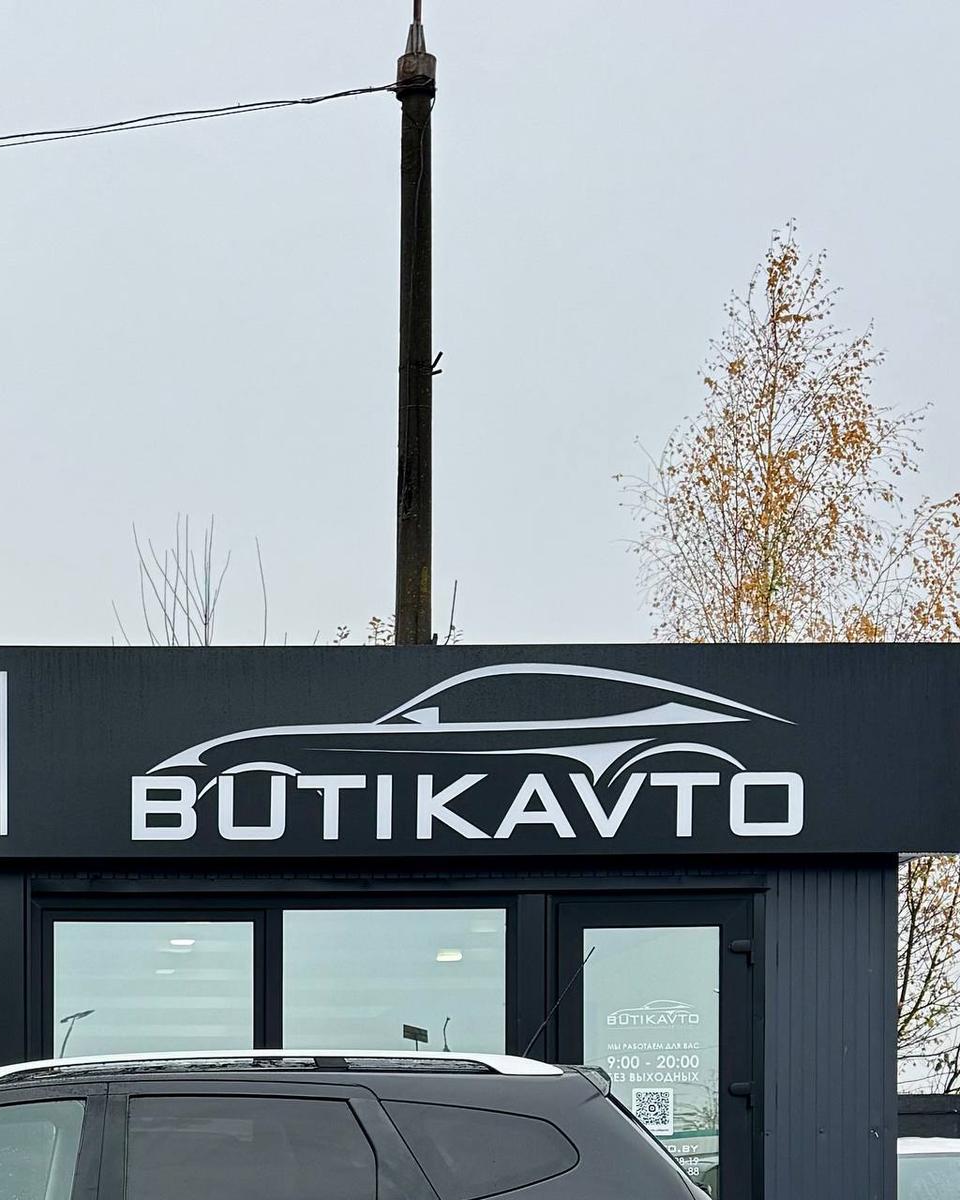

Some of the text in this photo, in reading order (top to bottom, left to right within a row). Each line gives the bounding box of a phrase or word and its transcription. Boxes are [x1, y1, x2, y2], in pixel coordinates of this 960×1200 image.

[132, 771, 804, 841] BUTIKAVTO
[607, 1014, 699, 1025] BUTIKAVTO
[607, 1056, 639, 1069] 9:00
[656, 1055, 699, 1068] 20:00
[629, 1072, 699, 1083] ВЫХОДНЫХ
